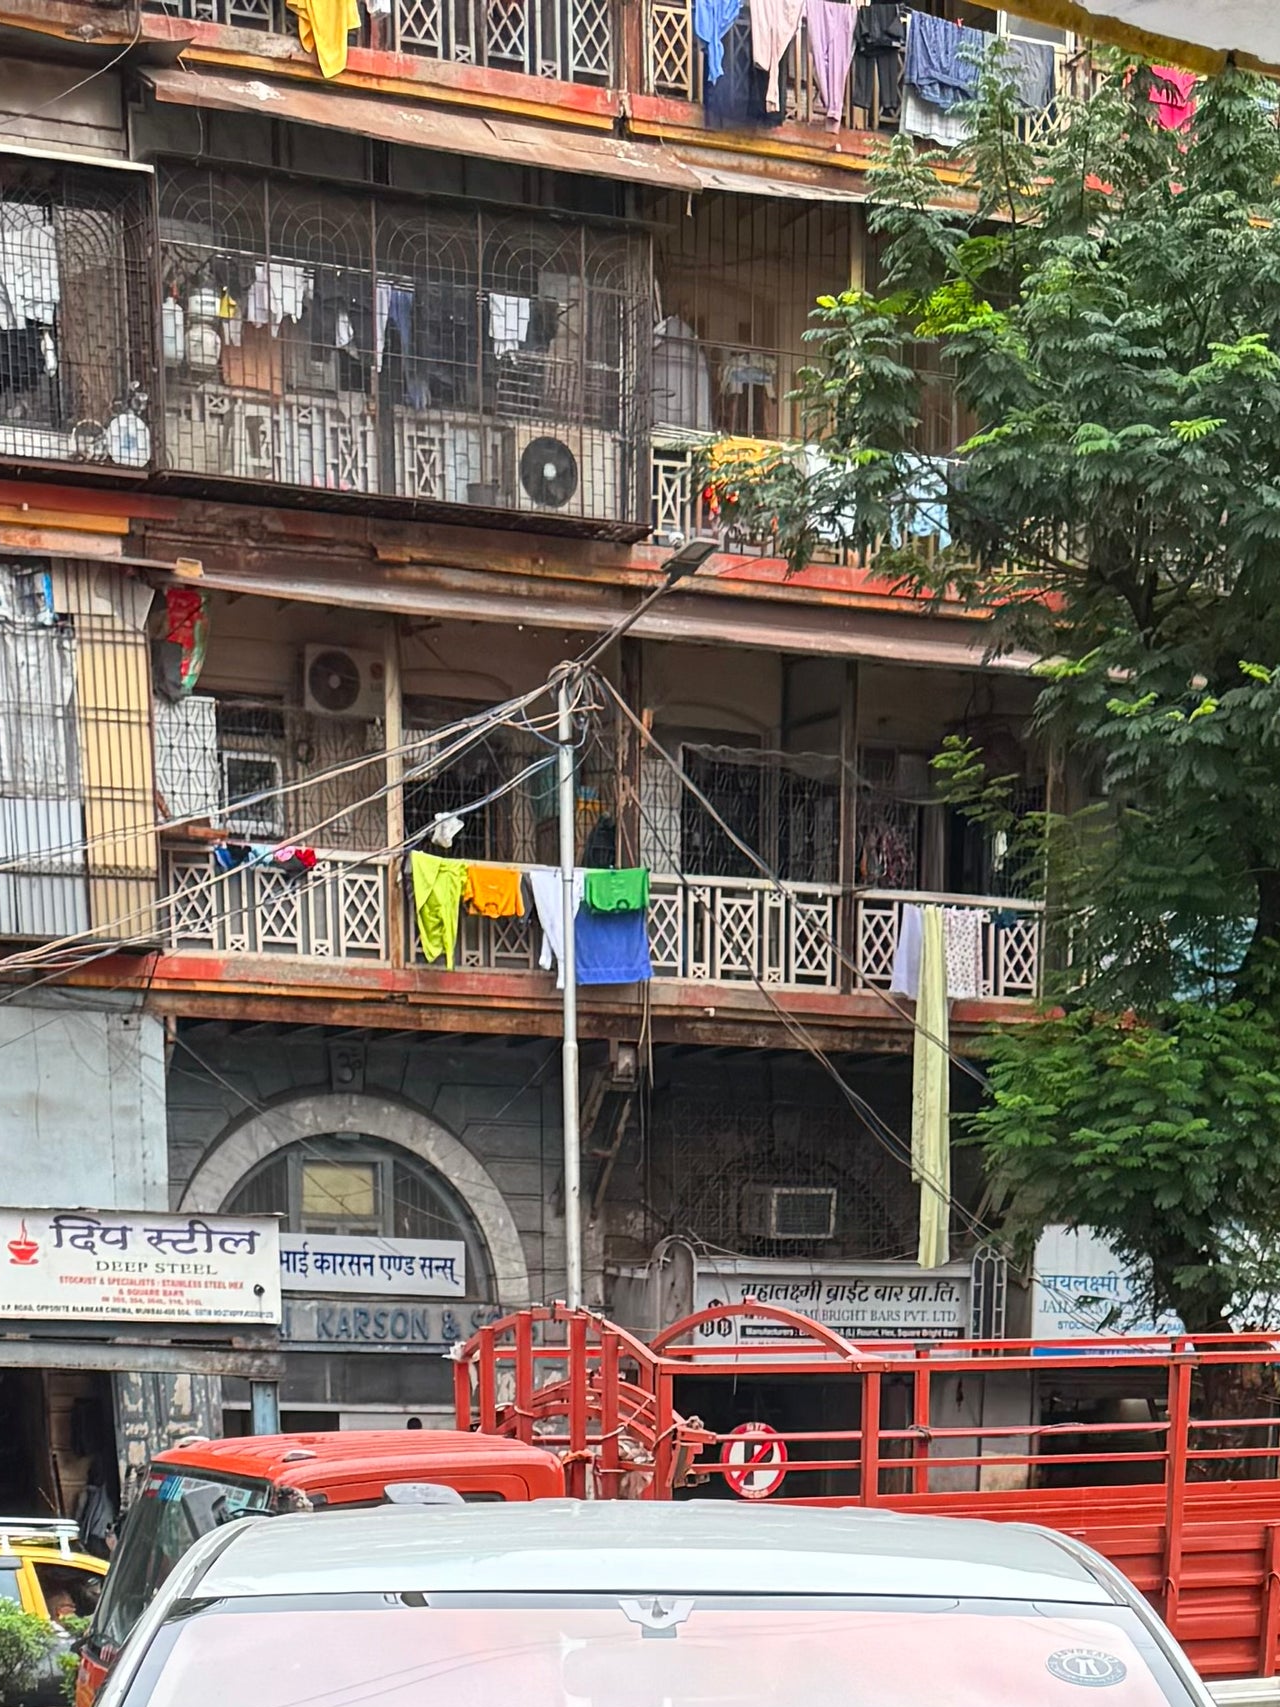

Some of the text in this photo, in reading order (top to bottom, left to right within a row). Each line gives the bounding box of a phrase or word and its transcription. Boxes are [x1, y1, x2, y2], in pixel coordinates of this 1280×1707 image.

[48, 1214, 261, 1256] दिप स्टील
[95, 1260, 219, 1276] DEEP STEEL
[312, 1250, 375, 1277] कारसन
[378, 1254, 416, 1281] एण्ड
[826, 1279, 870, 1305] ब्राईट
[873, 1283, 904, 1303] बार
[317, 1305, 429, 1341] KARSON
[441, 1308, 461, 1341] &
[821, 1308, 867, 1322] BRIGHT
[869, 1309, 903, 1323] BARS
[904, 1310, 930, 1323] PVT.
[932, 1310, 960, 1323] LTD.
